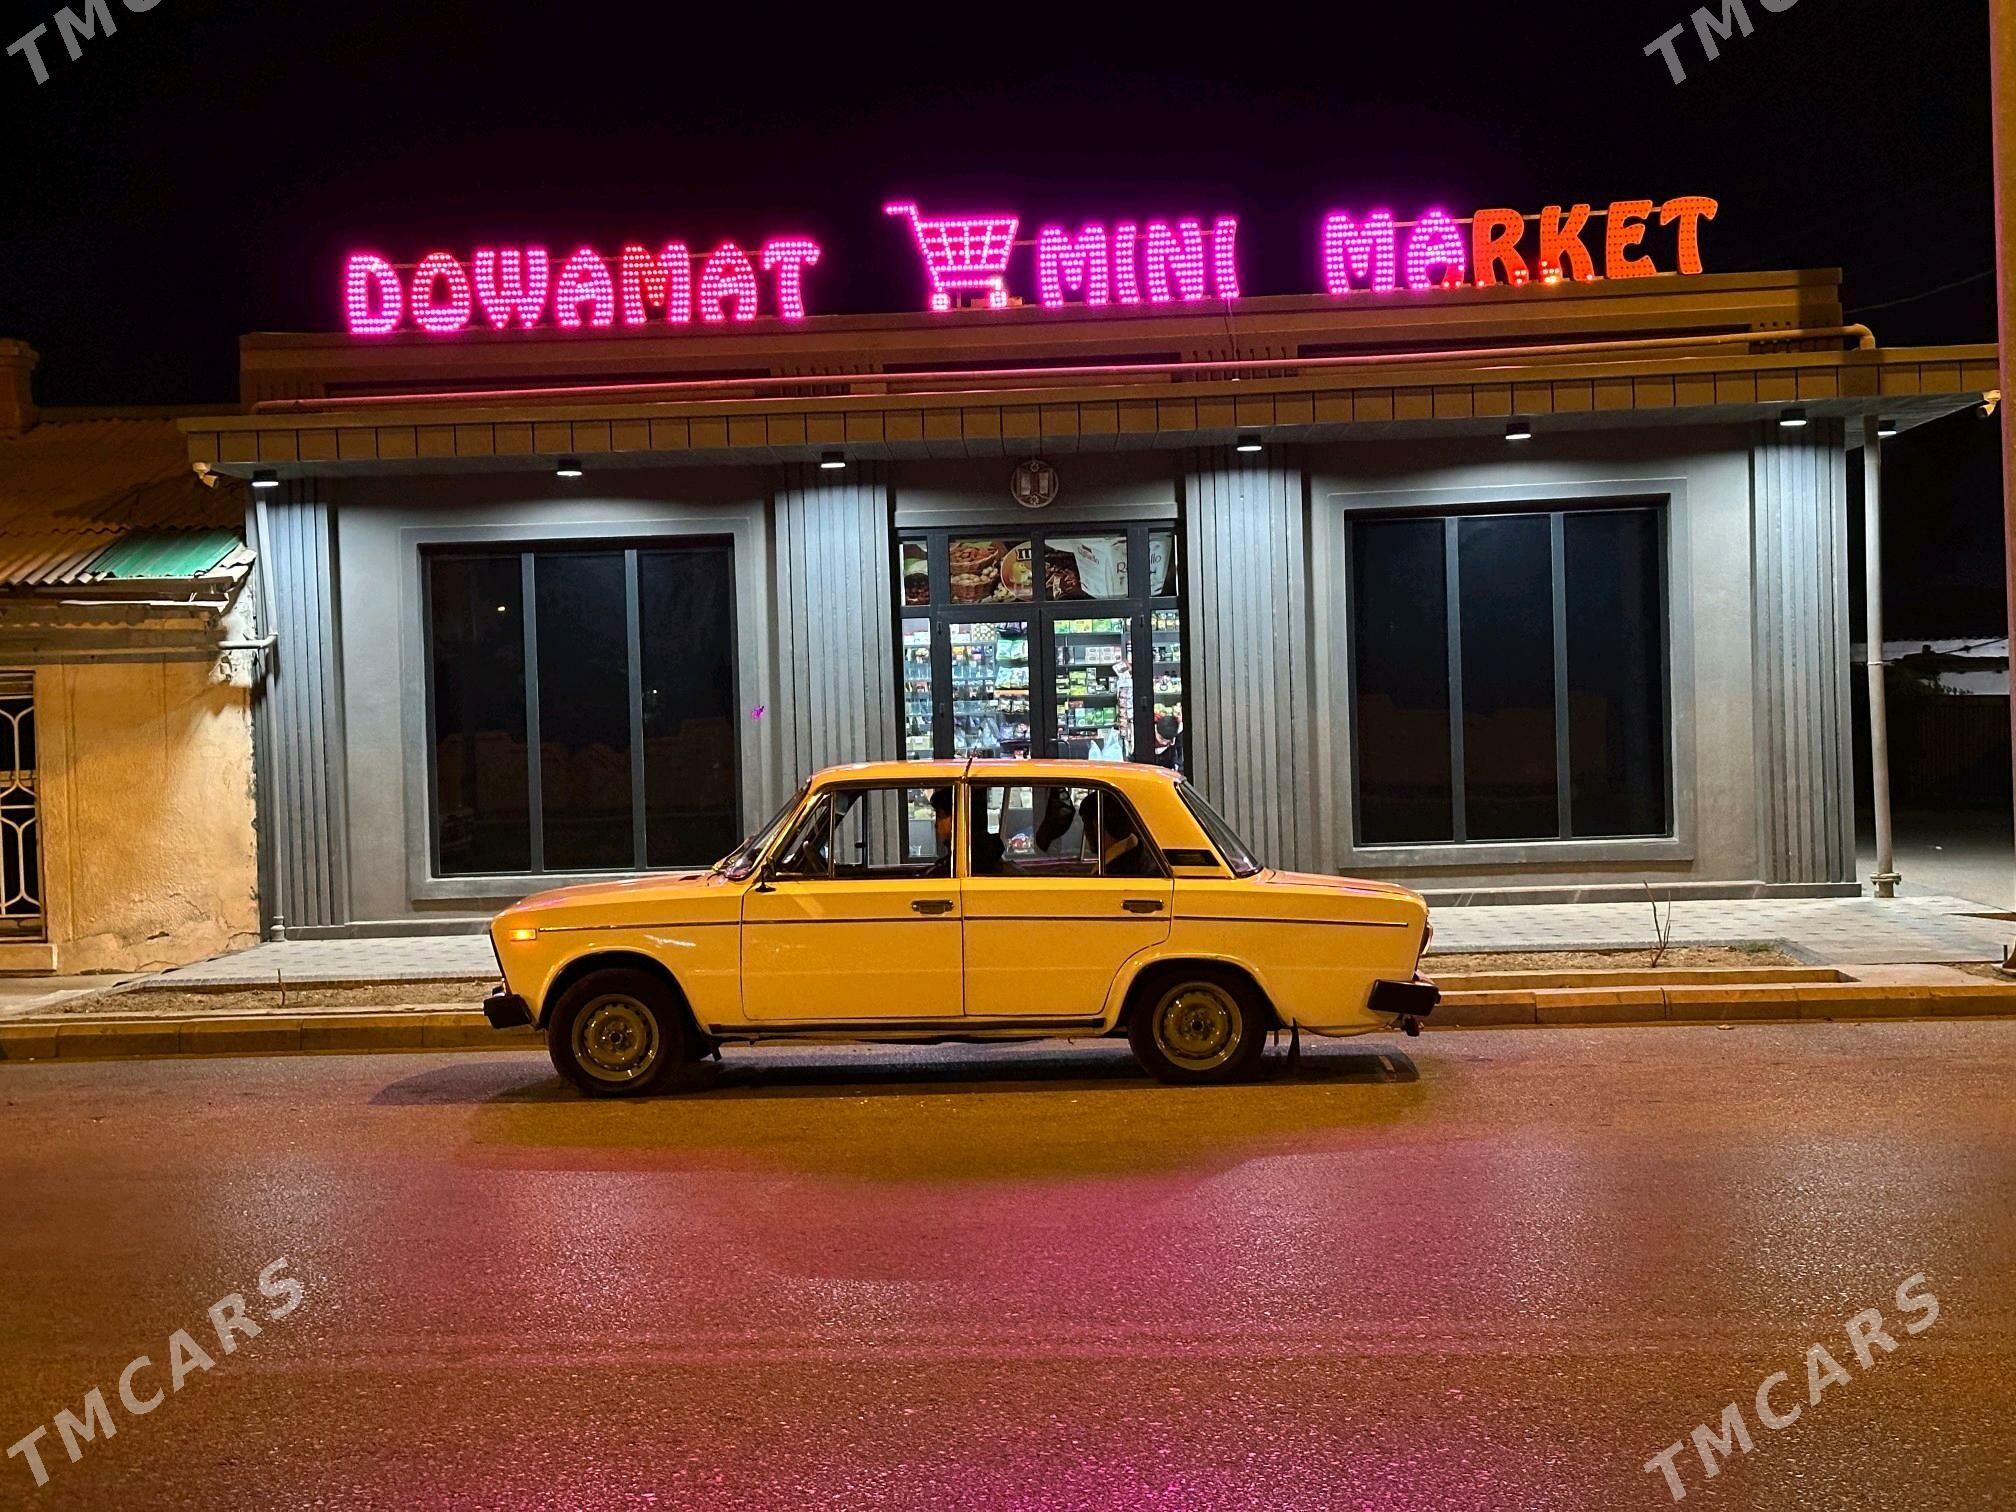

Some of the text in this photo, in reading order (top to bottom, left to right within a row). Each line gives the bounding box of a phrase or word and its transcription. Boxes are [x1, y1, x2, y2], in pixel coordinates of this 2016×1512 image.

[348, 195, 1719, 334] DOWAMAT MINI MARKET
